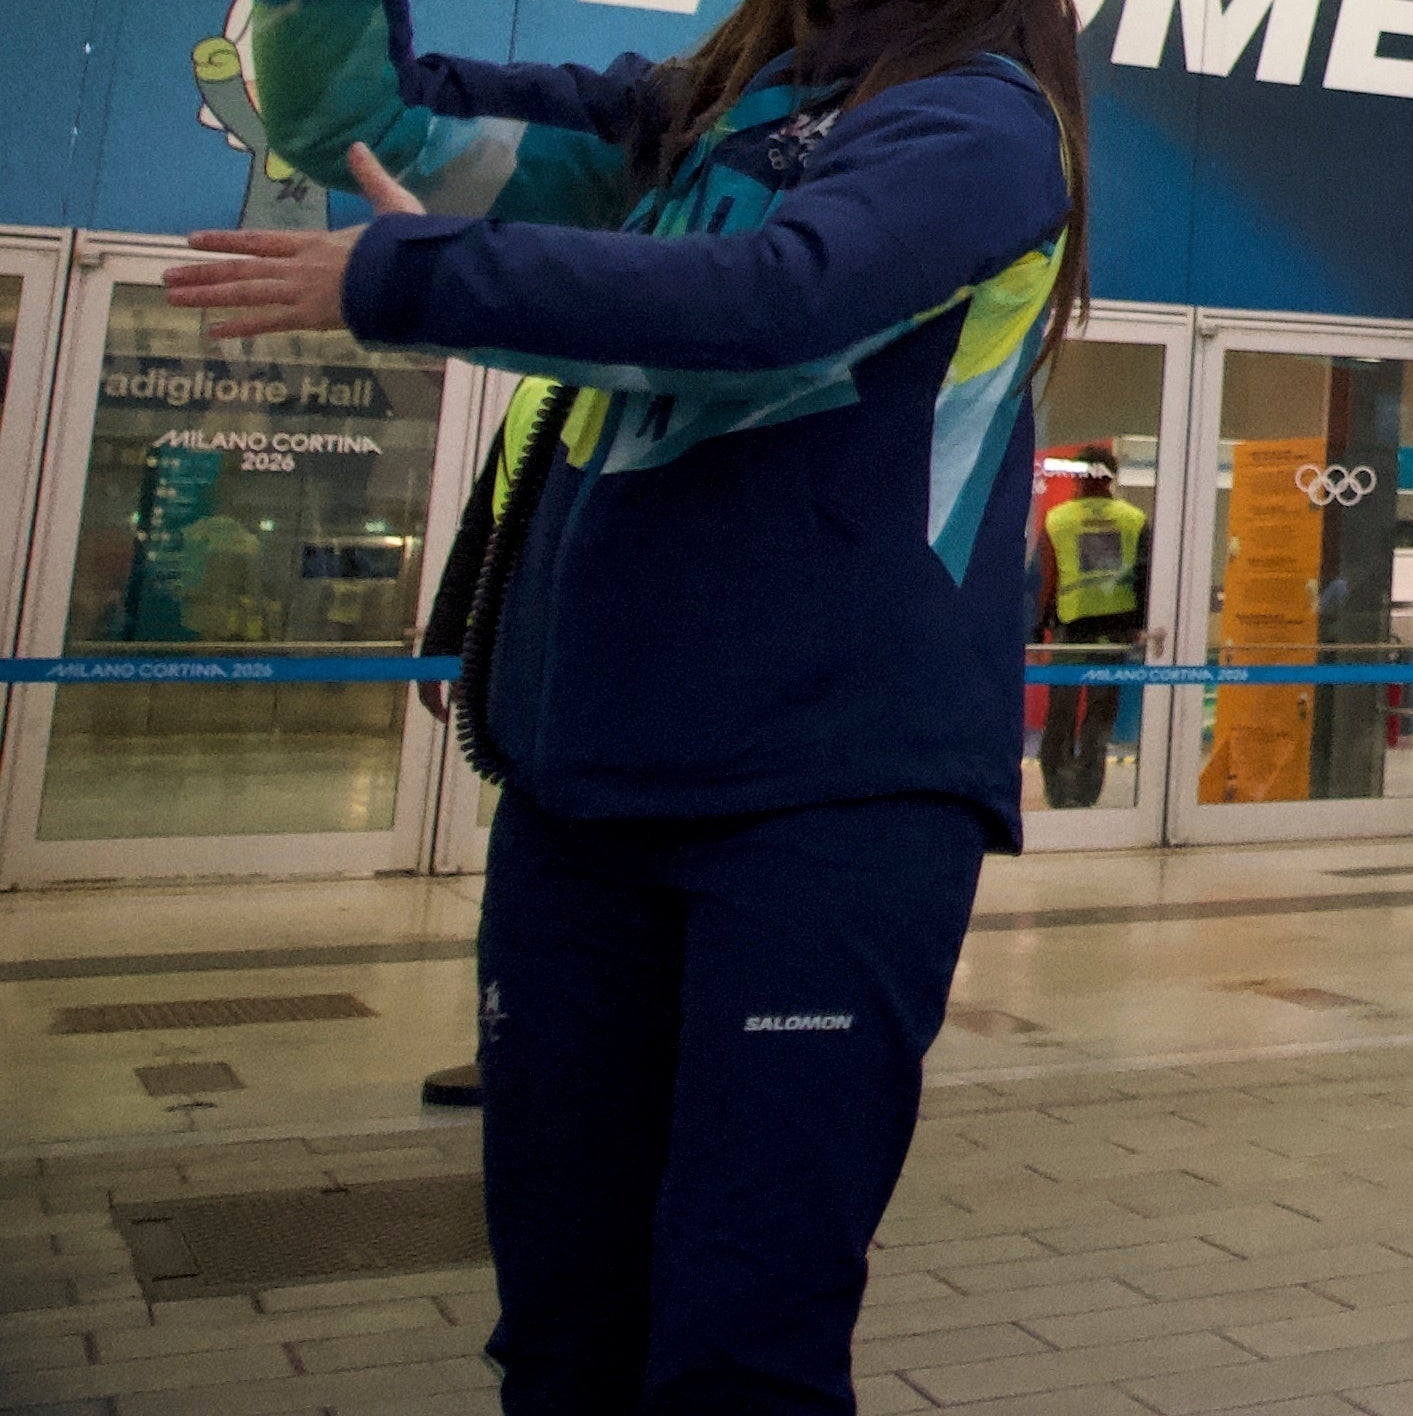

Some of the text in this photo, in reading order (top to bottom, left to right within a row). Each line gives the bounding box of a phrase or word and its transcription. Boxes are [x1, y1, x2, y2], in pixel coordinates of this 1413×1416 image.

[102, 367, 373, 408] adiglione Hall
[152, 429, 383, 455] MILANO CORTINA
[240, 451, 296, 472] 2026
[138, 662, 228, 679] CORTINA
[743, 1014, 854, 1033] SALOMON
